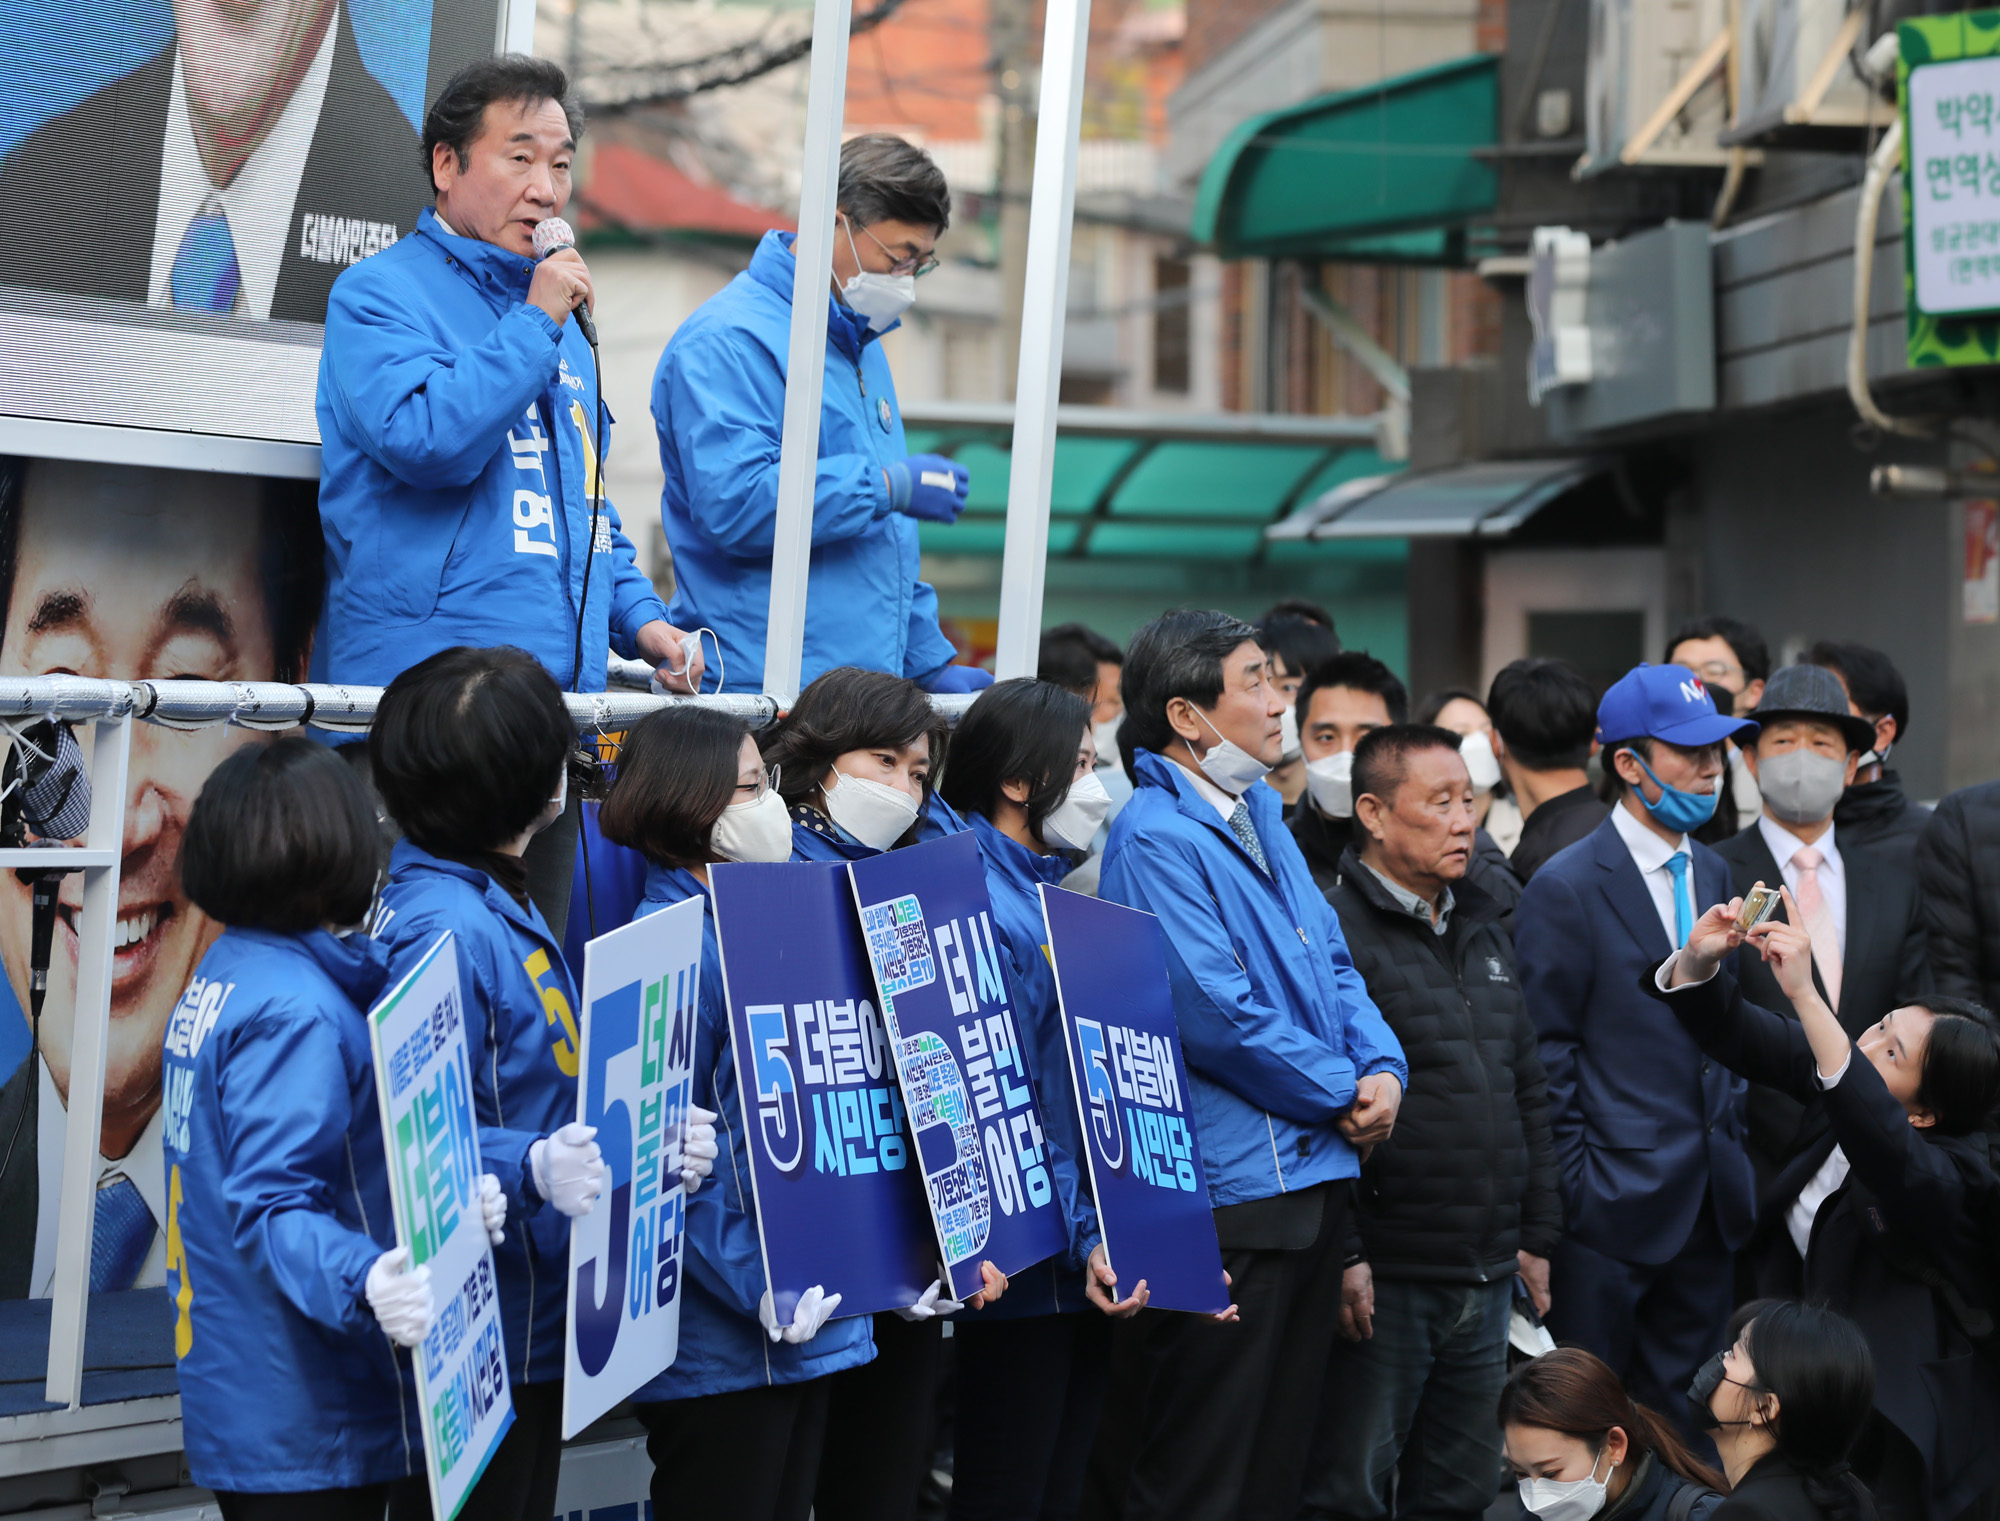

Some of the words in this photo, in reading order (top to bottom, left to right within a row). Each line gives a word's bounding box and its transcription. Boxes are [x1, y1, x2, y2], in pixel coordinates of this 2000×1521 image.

[1936, 94, 2000, 140] 박약
[506, 401, 558, 558] 낙연
[569, 397, 605, 503] 1
[523, 947, 580, 1077] 5
[745, 1004, 804, 1173] 5
[794, 998, 896, 1086] 더불어
[934, 917, 1027, 1217] 더불어
[967, 910, 1052, 1209] 시민당
[1107, 1025, 1182, 1113] 더불어
[396, 1044, 482, 1267] 더불어
[630, 974, 669, 1321] 더불어
[655, 963, 697, 1309] 시민당
[812, 1085, 908, 1178] 시민당
[1074, 1015, 1124, 1170] 5
[1127, 1107, 1197, 1193] 시민당
[576, 979, 642, 1377] 5
